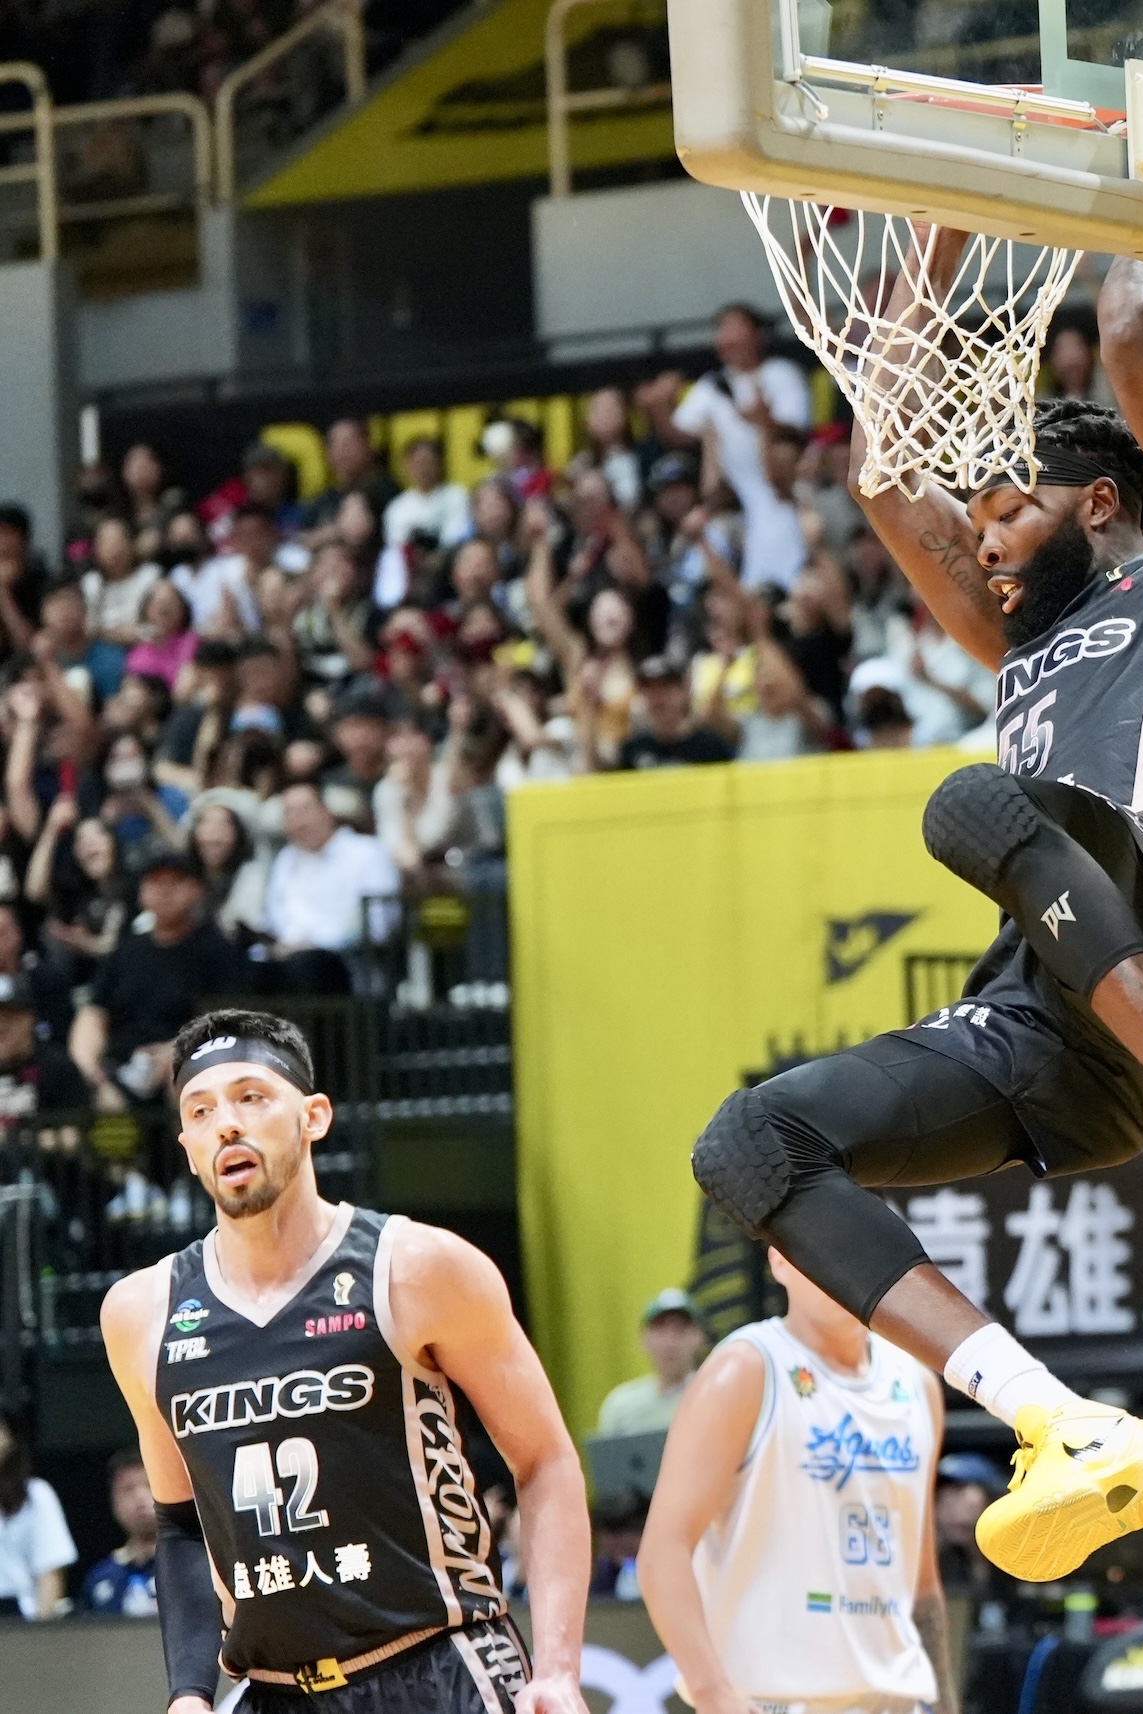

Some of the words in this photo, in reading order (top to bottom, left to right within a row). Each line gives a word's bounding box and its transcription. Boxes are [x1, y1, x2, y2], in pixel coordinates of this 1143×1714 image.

[996, 617, 1137, 719] INGS
[999, 689, 1058, 778] 55
[164, 1336, 211, 1364] TPBL
[305, 1311, 366, 1337] SAMPO
[170, 1363, 375, 1439] KINGS
[232, 1436, 330, 1537] 42
